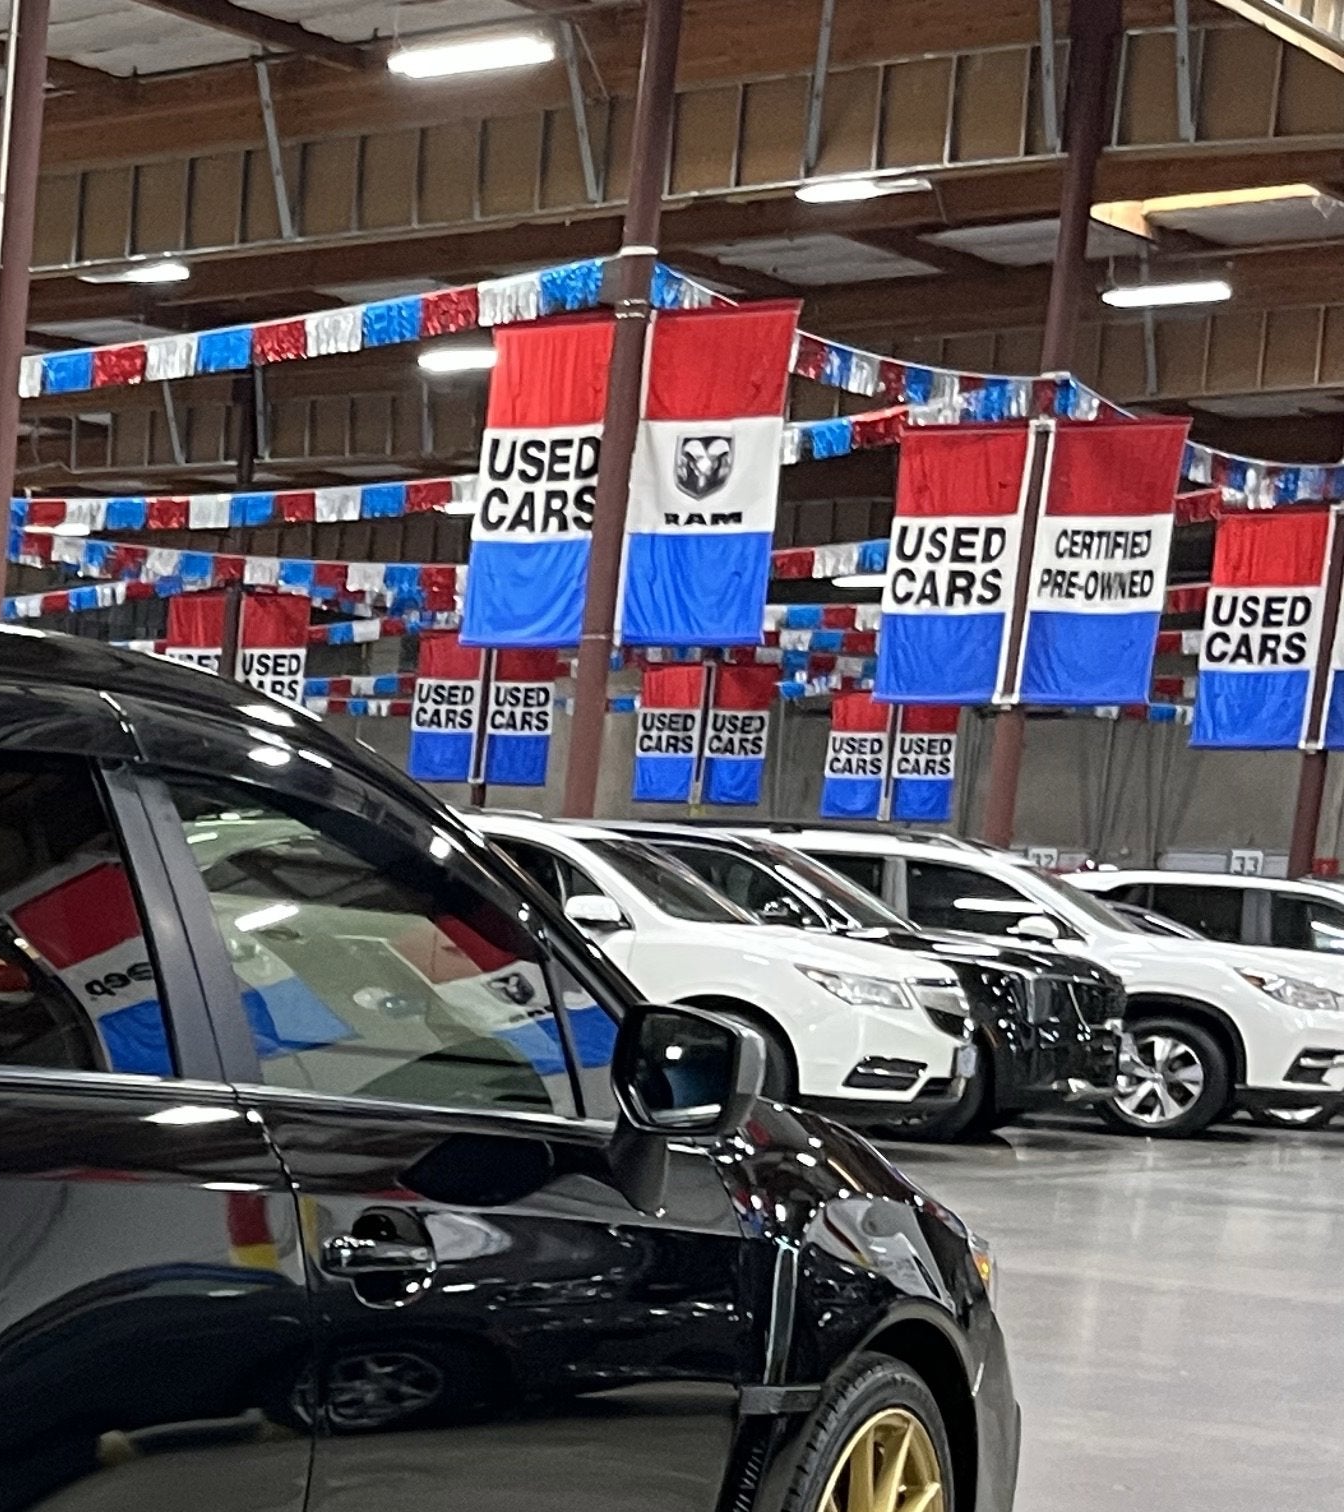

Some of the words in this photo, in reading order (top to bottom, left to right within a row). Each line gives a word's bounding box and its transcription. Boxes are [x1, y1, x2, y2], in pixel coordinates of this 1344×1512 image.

[488, 436, 602, 483] USED
[480, 486, 597, 532] CARS
[664, 511, 743, 526] RAM
[895, 525, 1006, 563] USED
[1055, 528, 1152, 559] CERTIFIED
[891, 567, 1002, 606] CARS
[1037, 568, 1154, 601] PRE-OWNED
[1212, 595, 1312, 628] USED
[1205, 631, 1307, 665] CARS
[242, 653, 301, 676] USED
[418, 684, 474, 705] USED
[495, 686, 550, 708] USED
[415, 707, 473, 729] CARS
[490, 709, 549, 731] CARS
[642, 713, 695, 732] USED
[712, 714, 765, 734] USED
[639, 734, 693, 753] CARS
[708, 735, 763, 755] CARS
[832, 737, 883, 755] USED
[900, 737, 952, 755] USED
[829, 757, 882, 775] CARS
[897, 757, 951, 775] CARS
